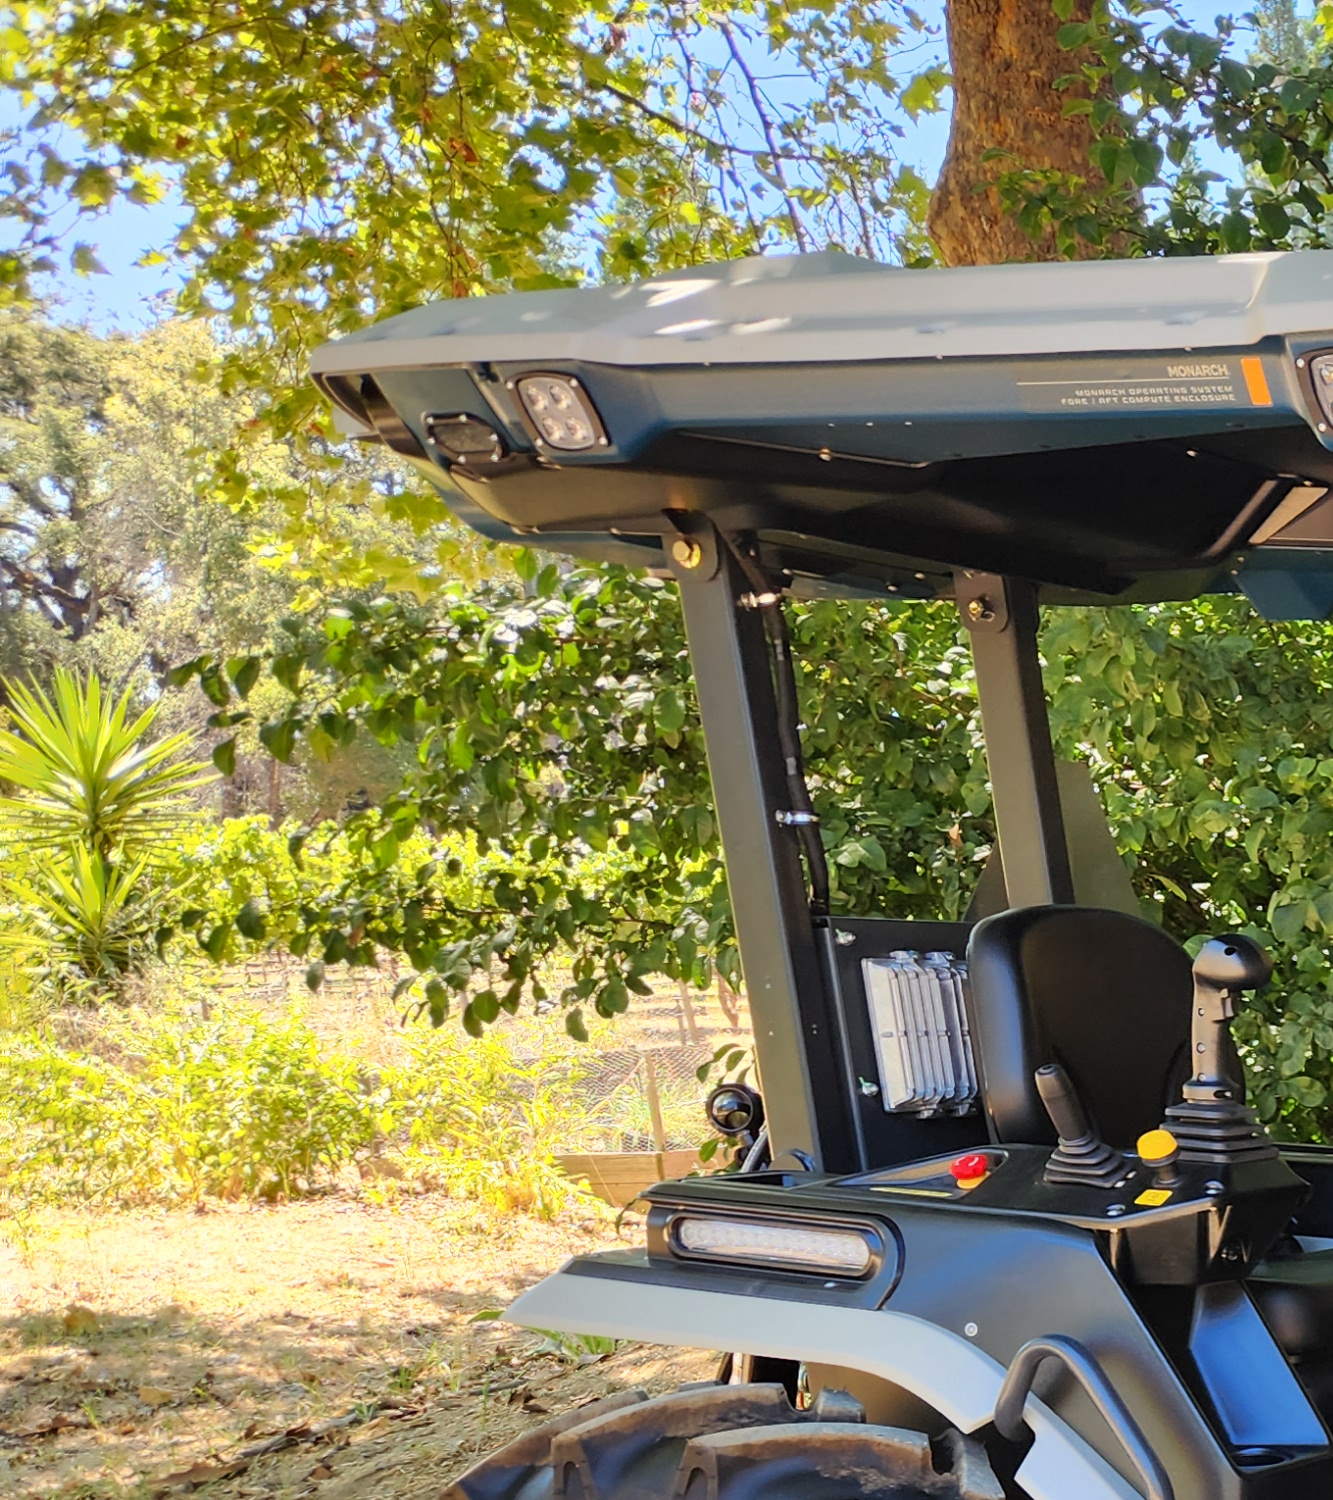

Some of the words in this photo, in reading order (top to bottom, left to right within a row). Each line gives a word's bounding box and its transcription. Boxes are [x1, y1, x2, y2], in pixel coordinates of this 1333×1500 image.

[1167, 364, 1229, 378] MONARCH
[1075, 388, 1126, 397] MONARCH
[1128, 386, 1188, 396] OPERATING
[1190, 385, 1233, 395] SYSTEM
[1122, 395, 1171, 404] COMPUTE
[1174, 393, 1235, 402] ENCLOSURE
